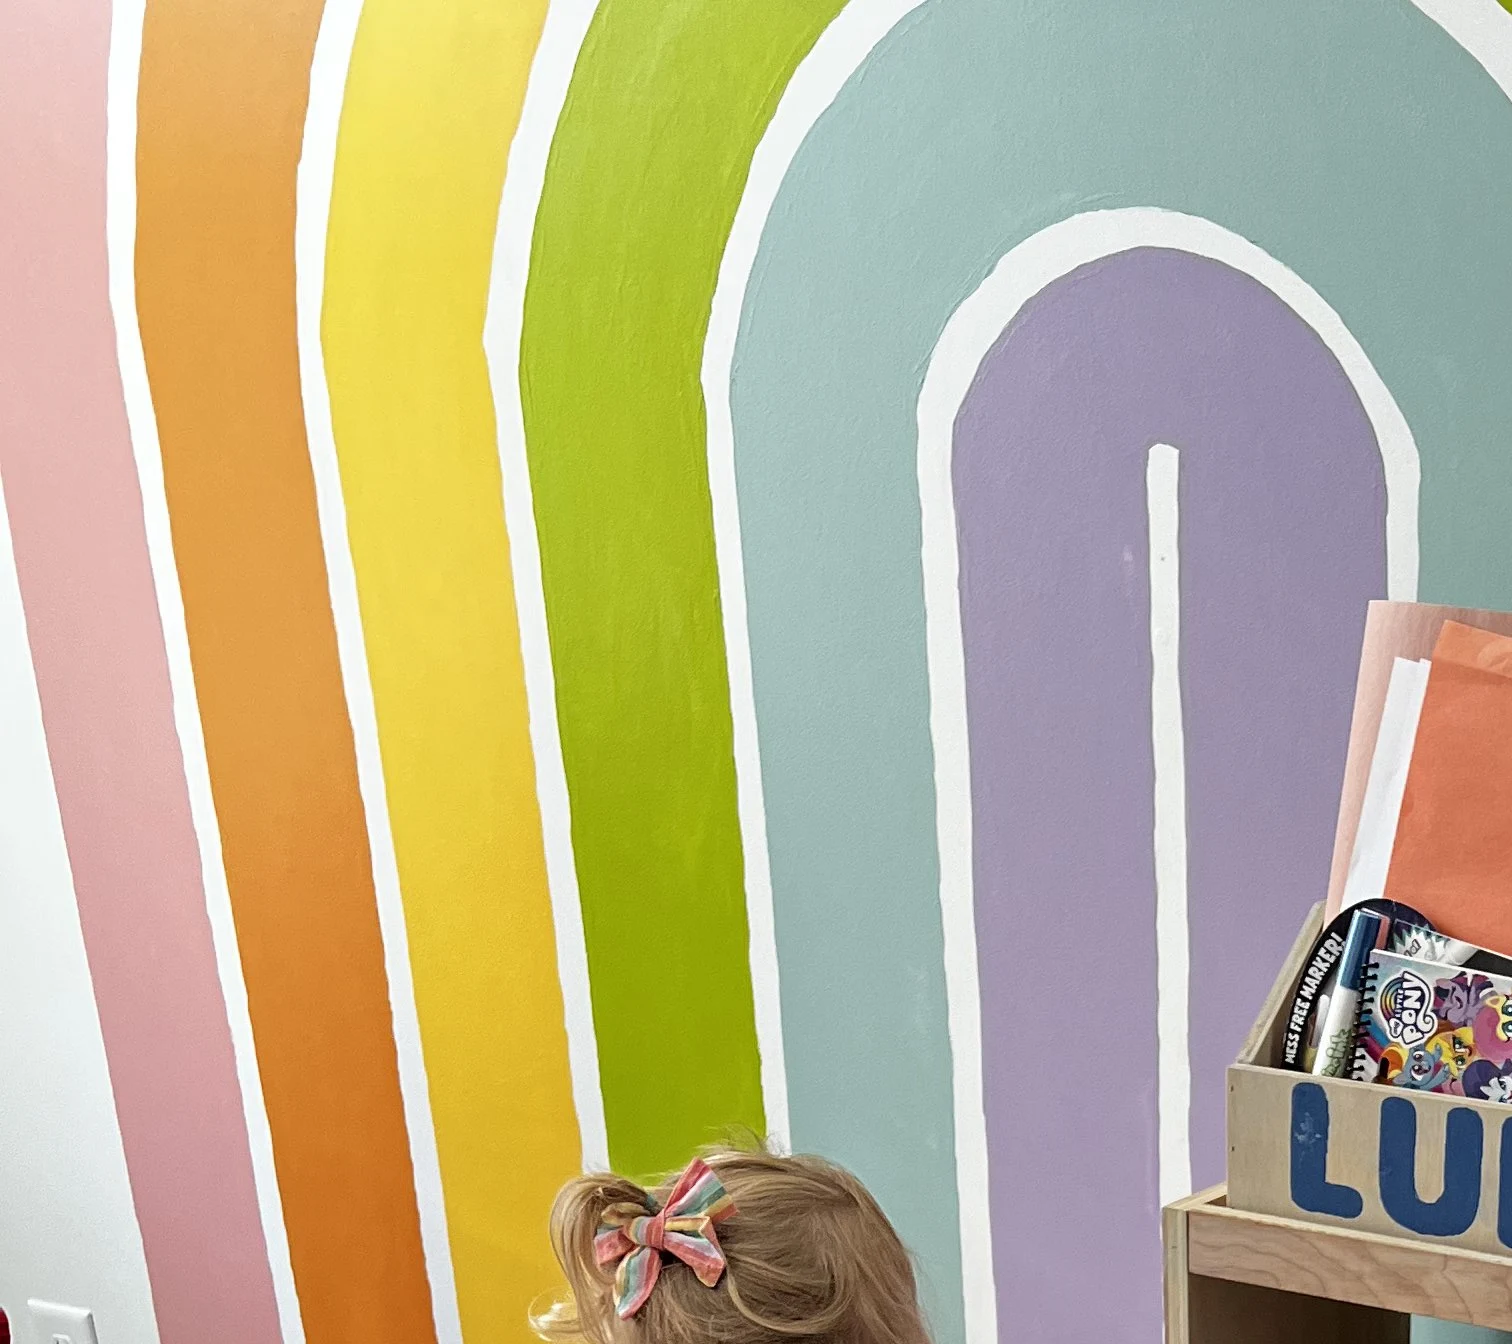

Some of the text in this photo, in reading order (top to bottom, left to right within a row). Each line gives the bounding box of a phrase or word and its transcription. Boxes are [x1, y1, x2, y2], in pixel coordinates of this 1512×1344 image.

[1284, 931, 1344, 1064] MESS FREE MARKER!
[1401, 970, 1436, 1046] PONY
